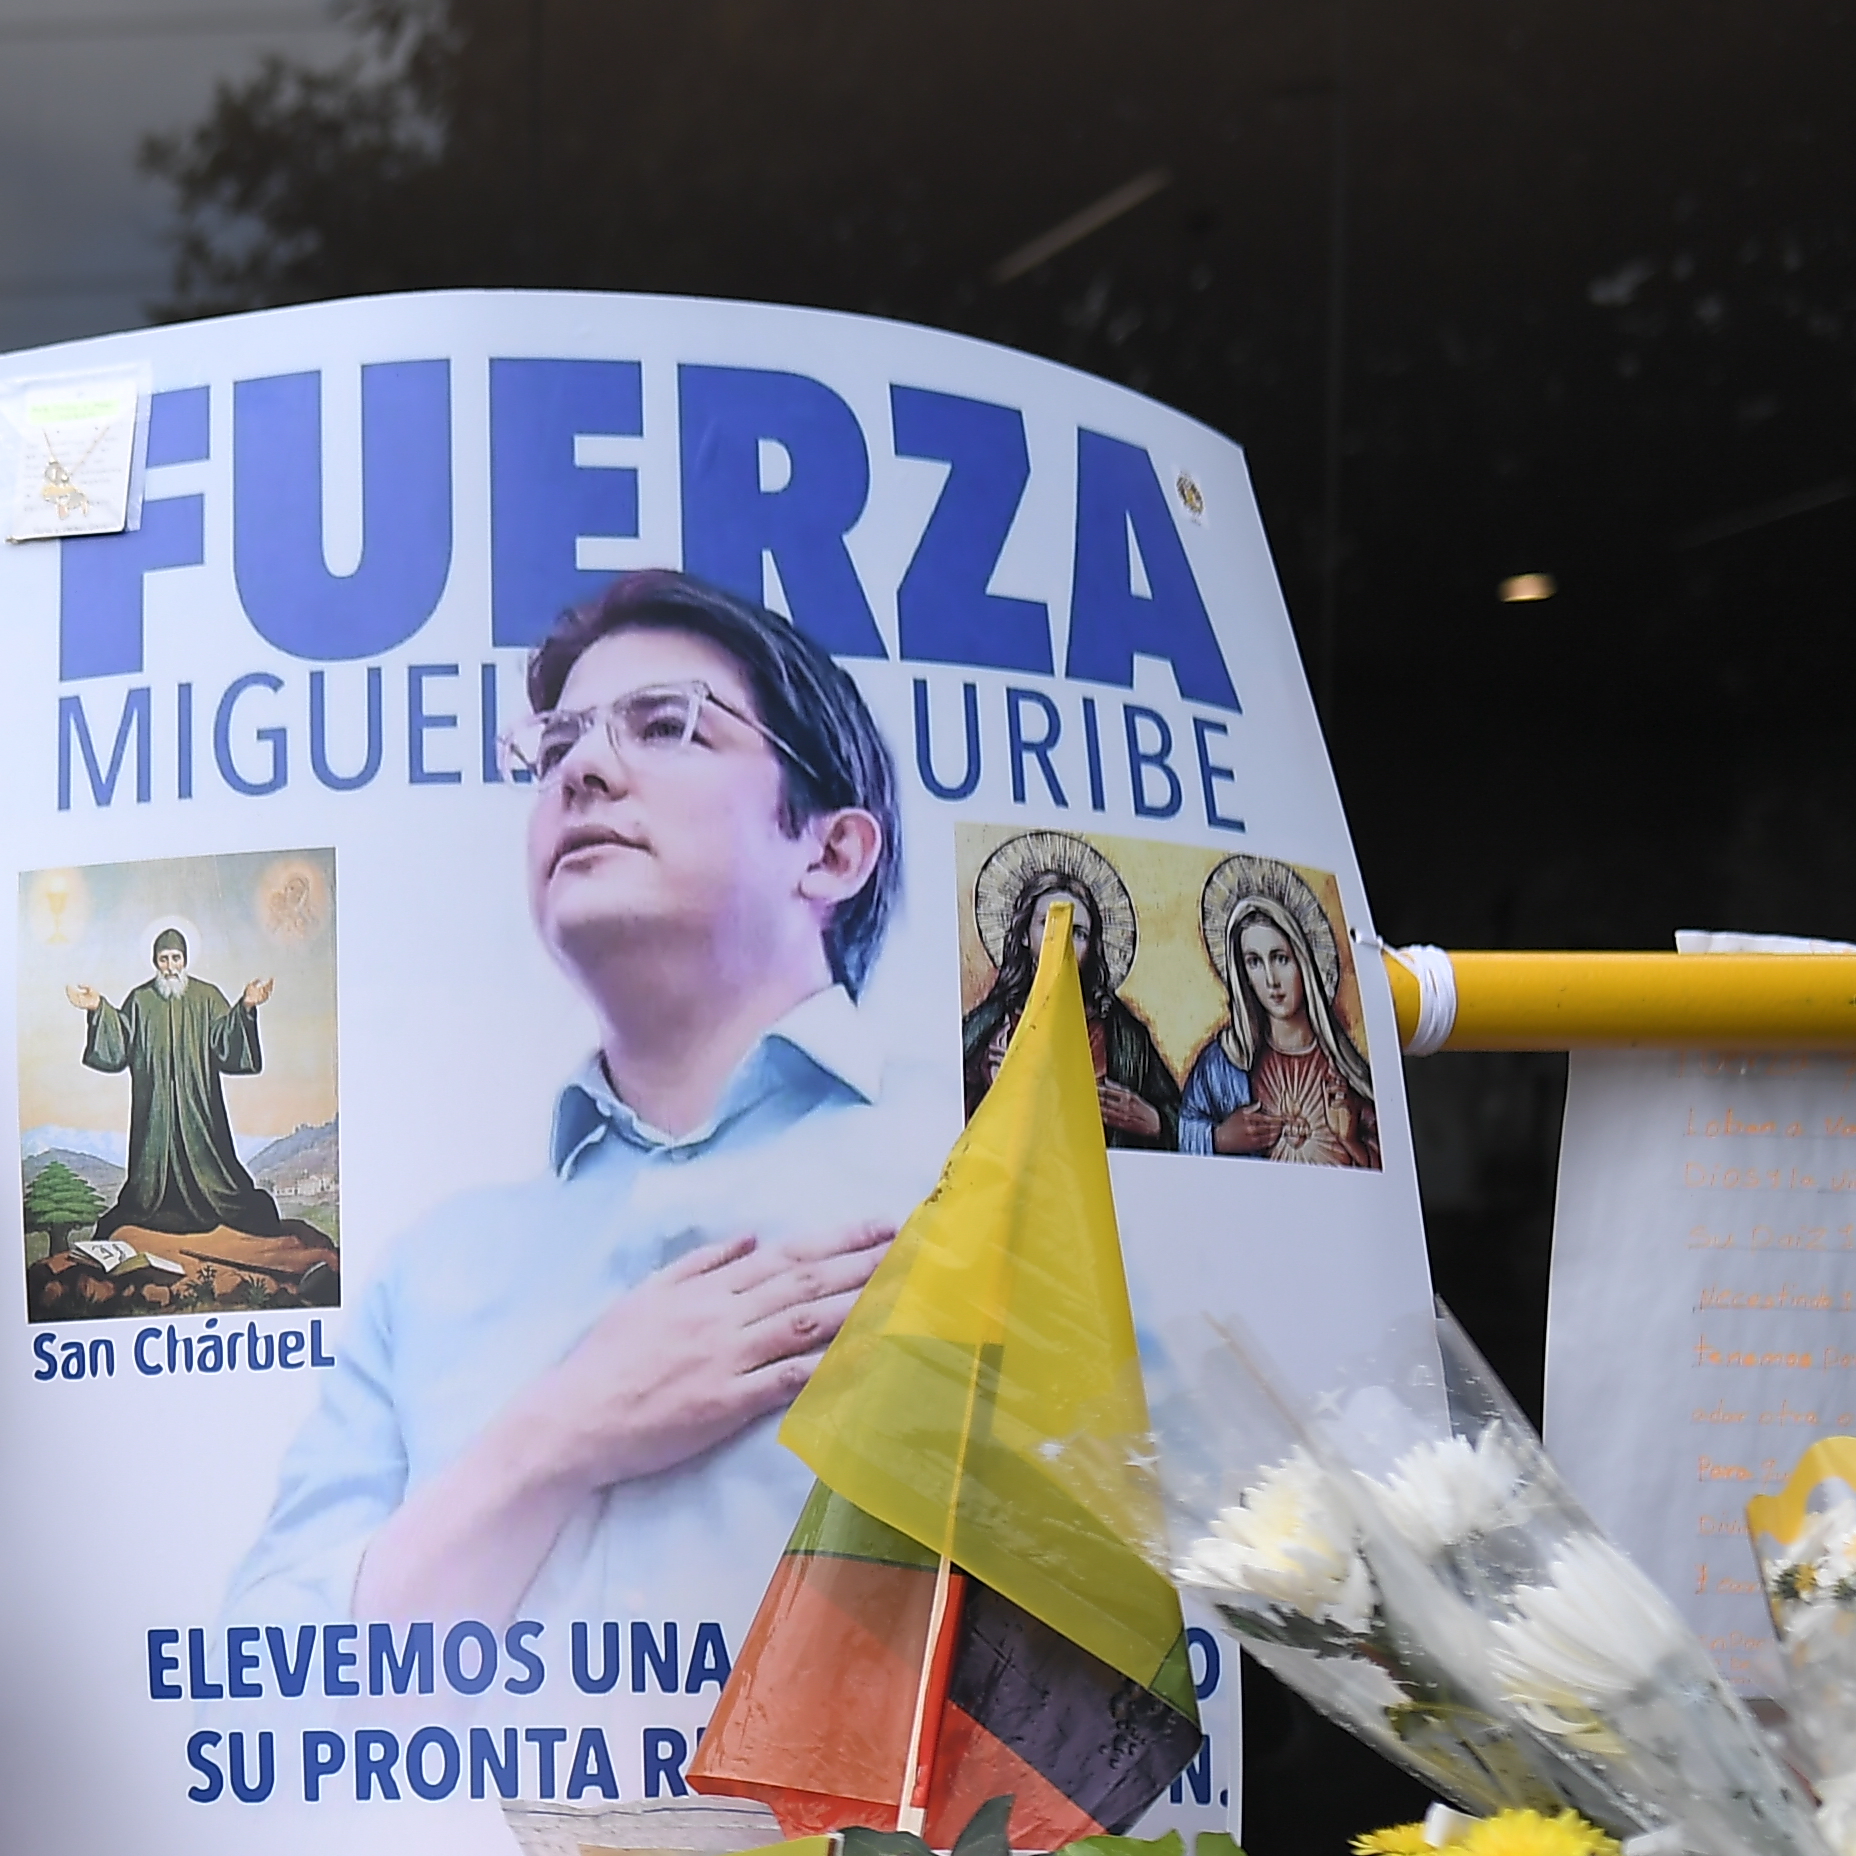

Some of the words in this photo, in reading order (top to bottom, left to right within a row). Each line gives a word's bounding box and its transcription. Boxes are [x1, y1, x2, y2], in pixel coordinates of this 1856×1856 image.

[60, 357, 1242, 714] FUERZA
[58, 663, 534, 811] MIGUEL
[913, 679, 1246, 833] URIBE
[33, 1331, 115, 1381] San
[147, 1619, 546, 1700] ELEVEMOS
[571, 1619, 734, 1695] UNA
[186, 1727, 275, 1803] SU
[301, 1725, 621, 1802] PRONTA
